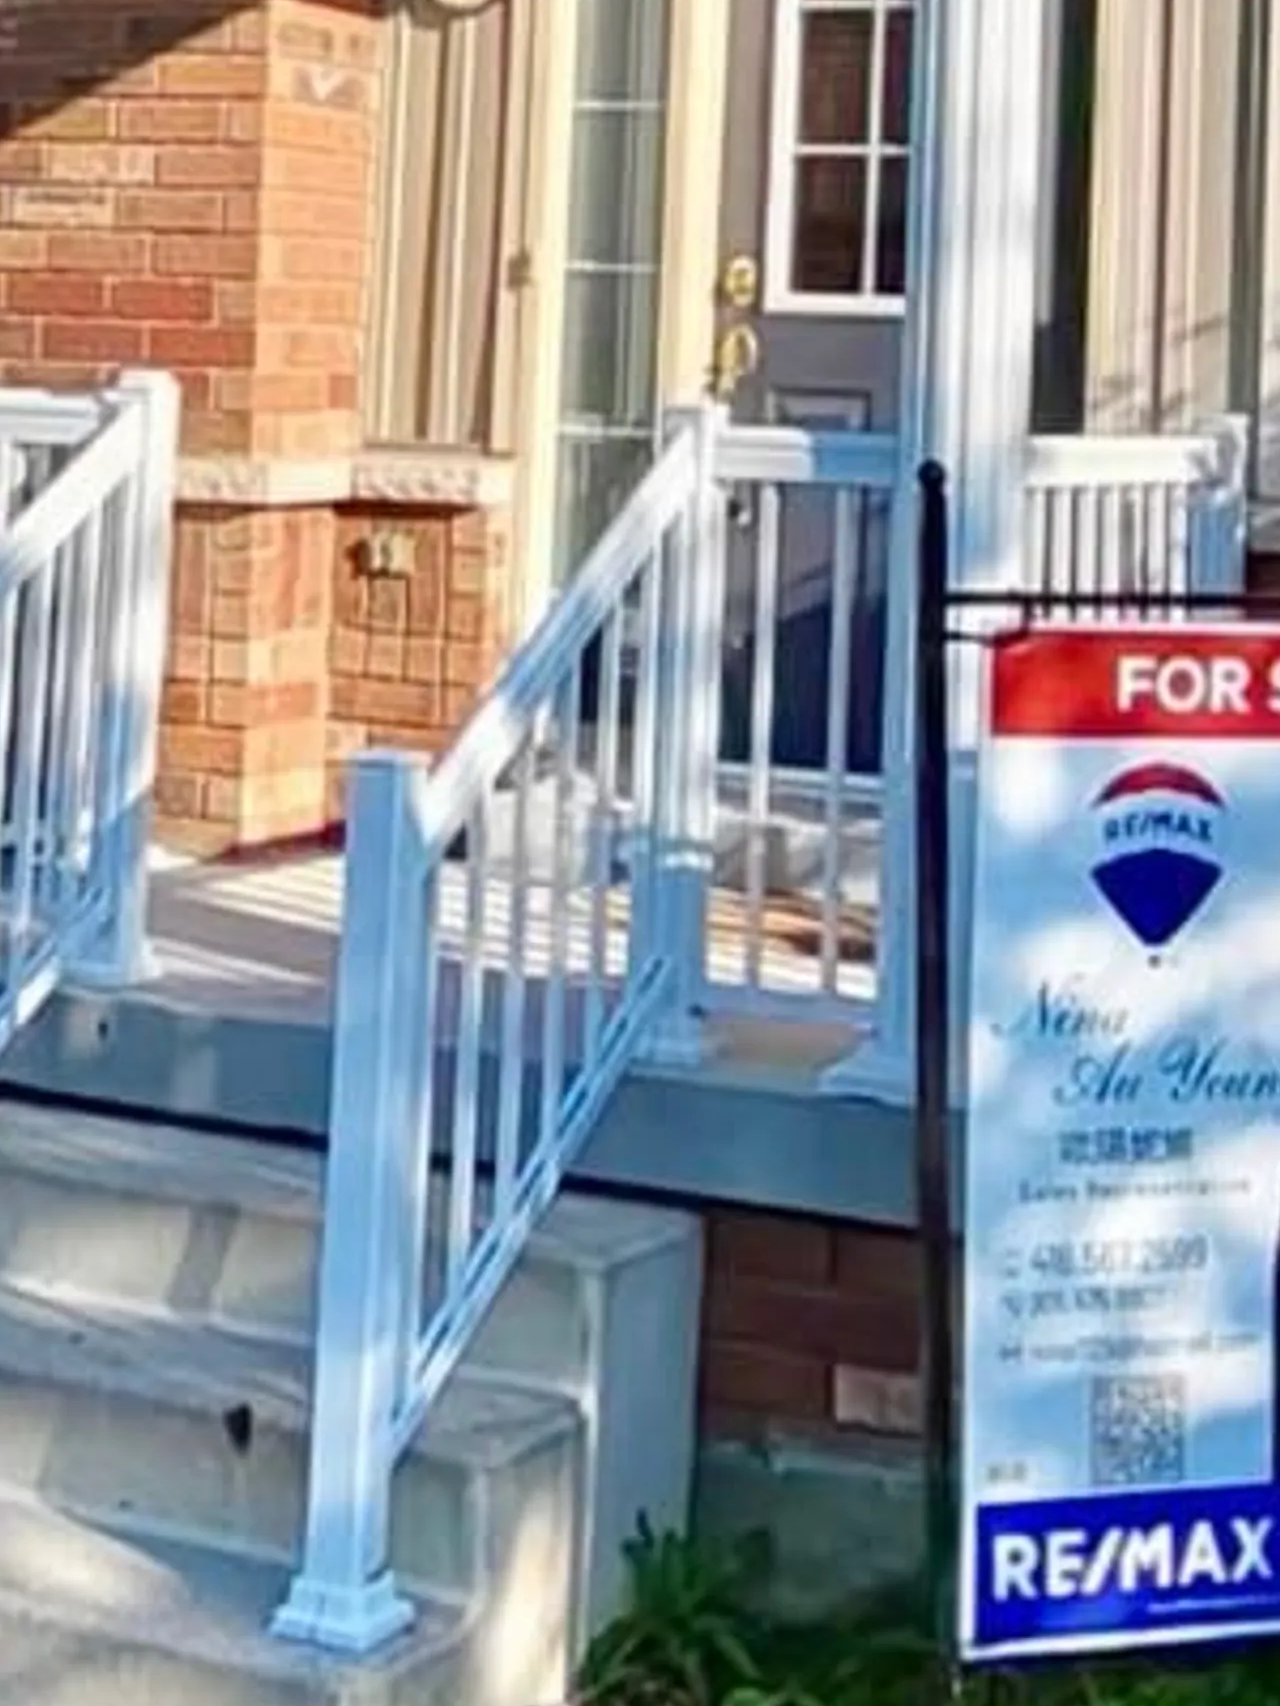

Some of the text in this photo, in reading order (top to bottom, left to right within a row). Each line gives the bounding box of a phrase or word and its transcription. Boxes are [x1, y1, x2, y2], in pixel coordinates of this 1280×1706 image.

[1116, 657, 1251, 714] FOR
[1103, 810, 1214, 843] RE/MAX
[990, 980, 1130, 1037] Nina
[1052, 1044, 1145, 1107] Au
[990, 1516, 1274, 1603] RE/MAX
